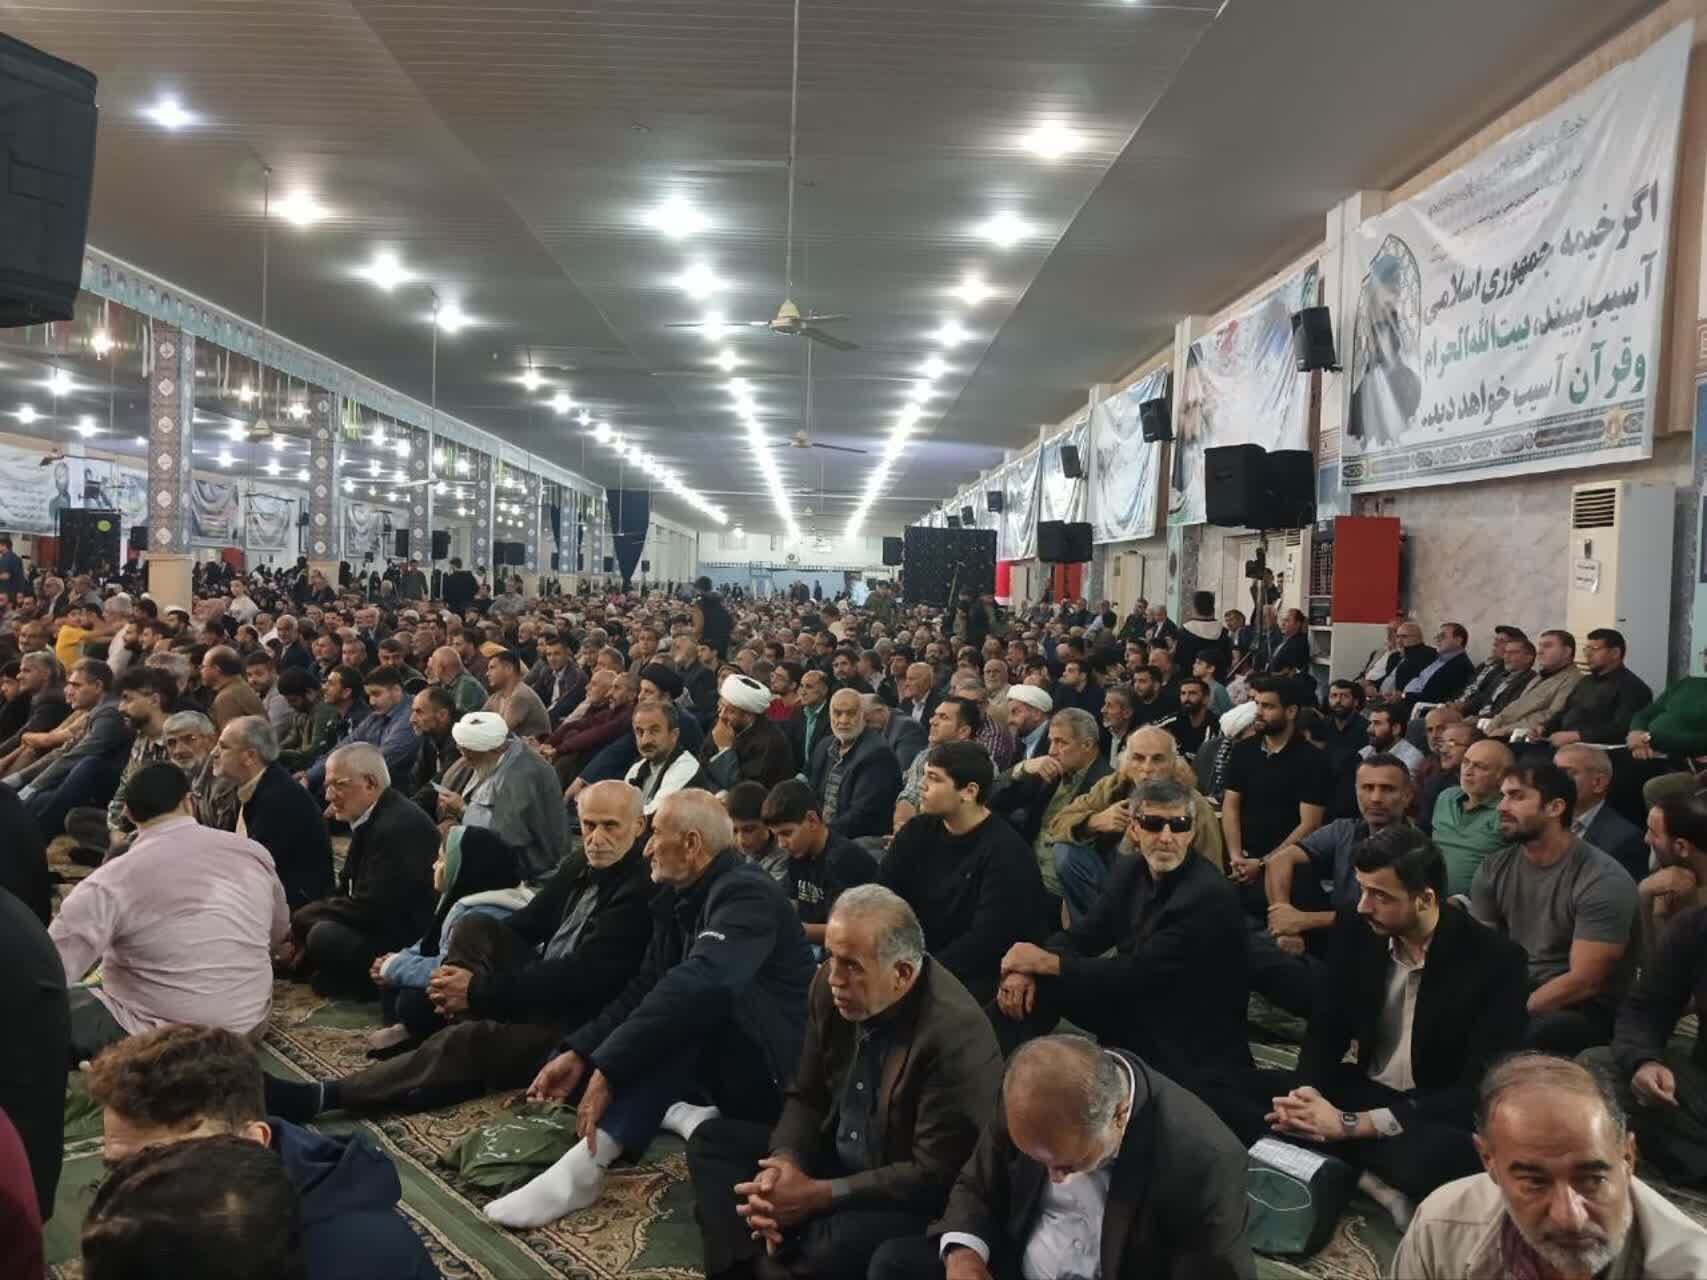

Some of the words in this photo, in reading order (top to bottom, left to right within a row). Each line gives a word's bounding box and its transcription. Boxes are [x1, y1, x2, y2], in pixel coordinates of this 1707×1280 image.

[1559, 203, 1616, 260] خیمه
[1616, 178, 1658, 250] اگر
[1423, 267, 1482, 326] اسلامی
[1481, 242, 1554, 304] جمهوری
[1586, 251, 1658, 328] آسیب
[1424, 325, 1470, 381] الحرام
[1513, 352, 1568, 414] آسیب
[1458, 376, 1511, 425] خواهد
